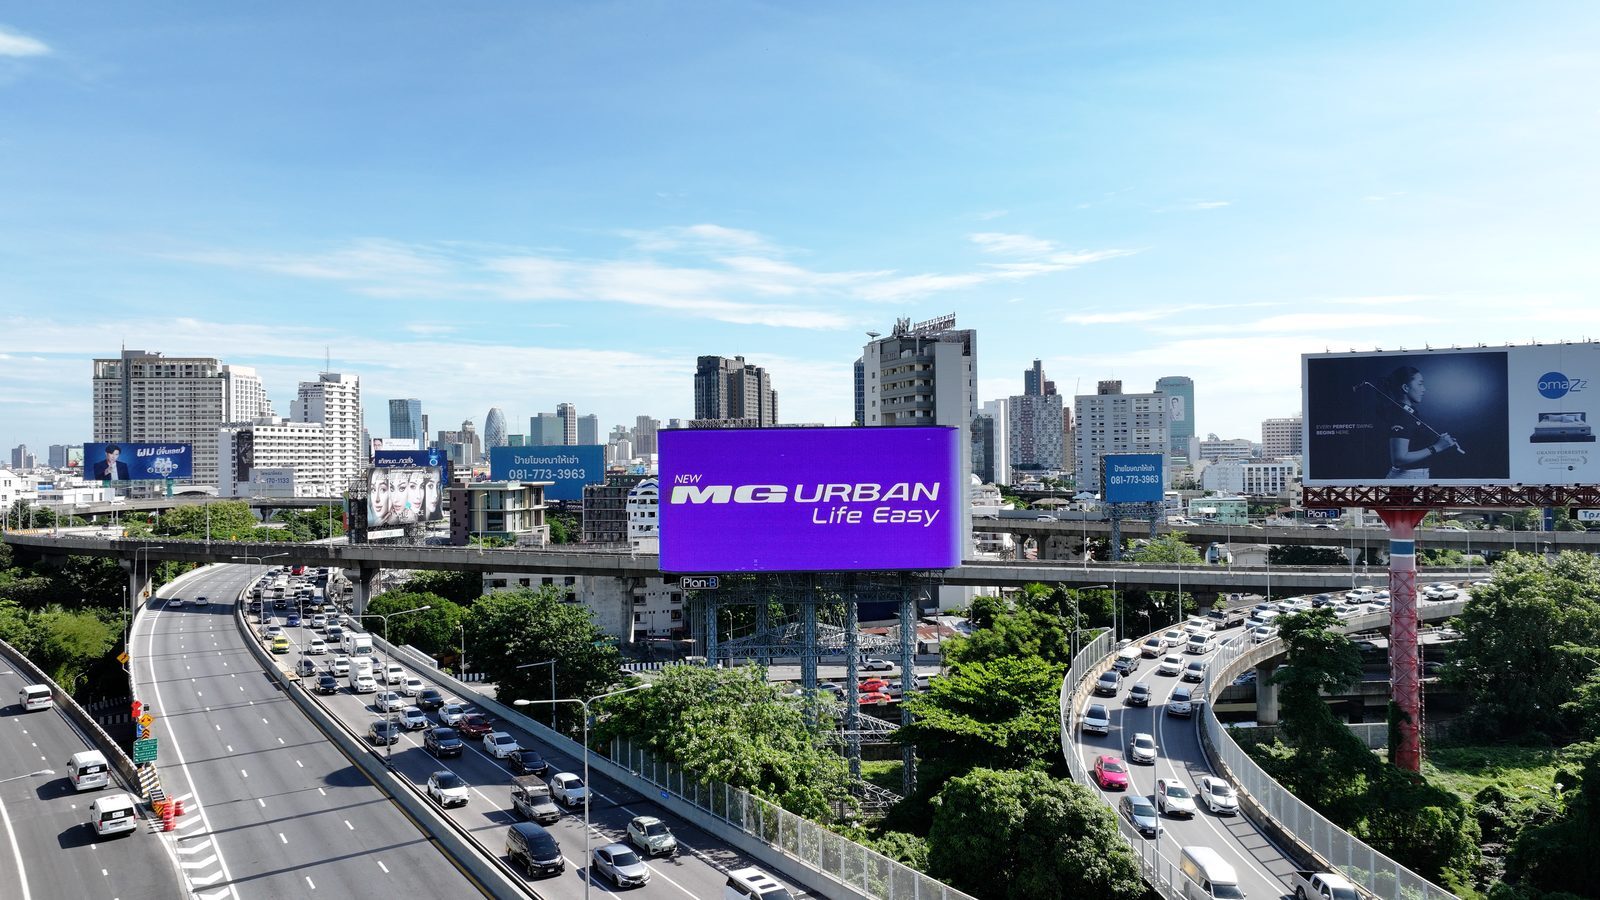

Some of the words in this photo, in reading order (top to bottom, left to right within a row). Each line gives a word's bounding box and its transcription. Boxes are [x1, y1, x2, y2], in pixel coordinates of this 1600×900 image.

[514, 454, 579, 465] ป้ายโฆษณาให้เช่า
[508, 469, 586, 480] 081-773-3963
[674, 474, 702, 484] NEW
[1110, 475, 1159, 484] 081-773-3963
[670, 484, 789, 505] MG
[794, 482, 941, 503] URBAN
[812, 505, 863, 525] Life
[872, 506, 940, 528] Easy
